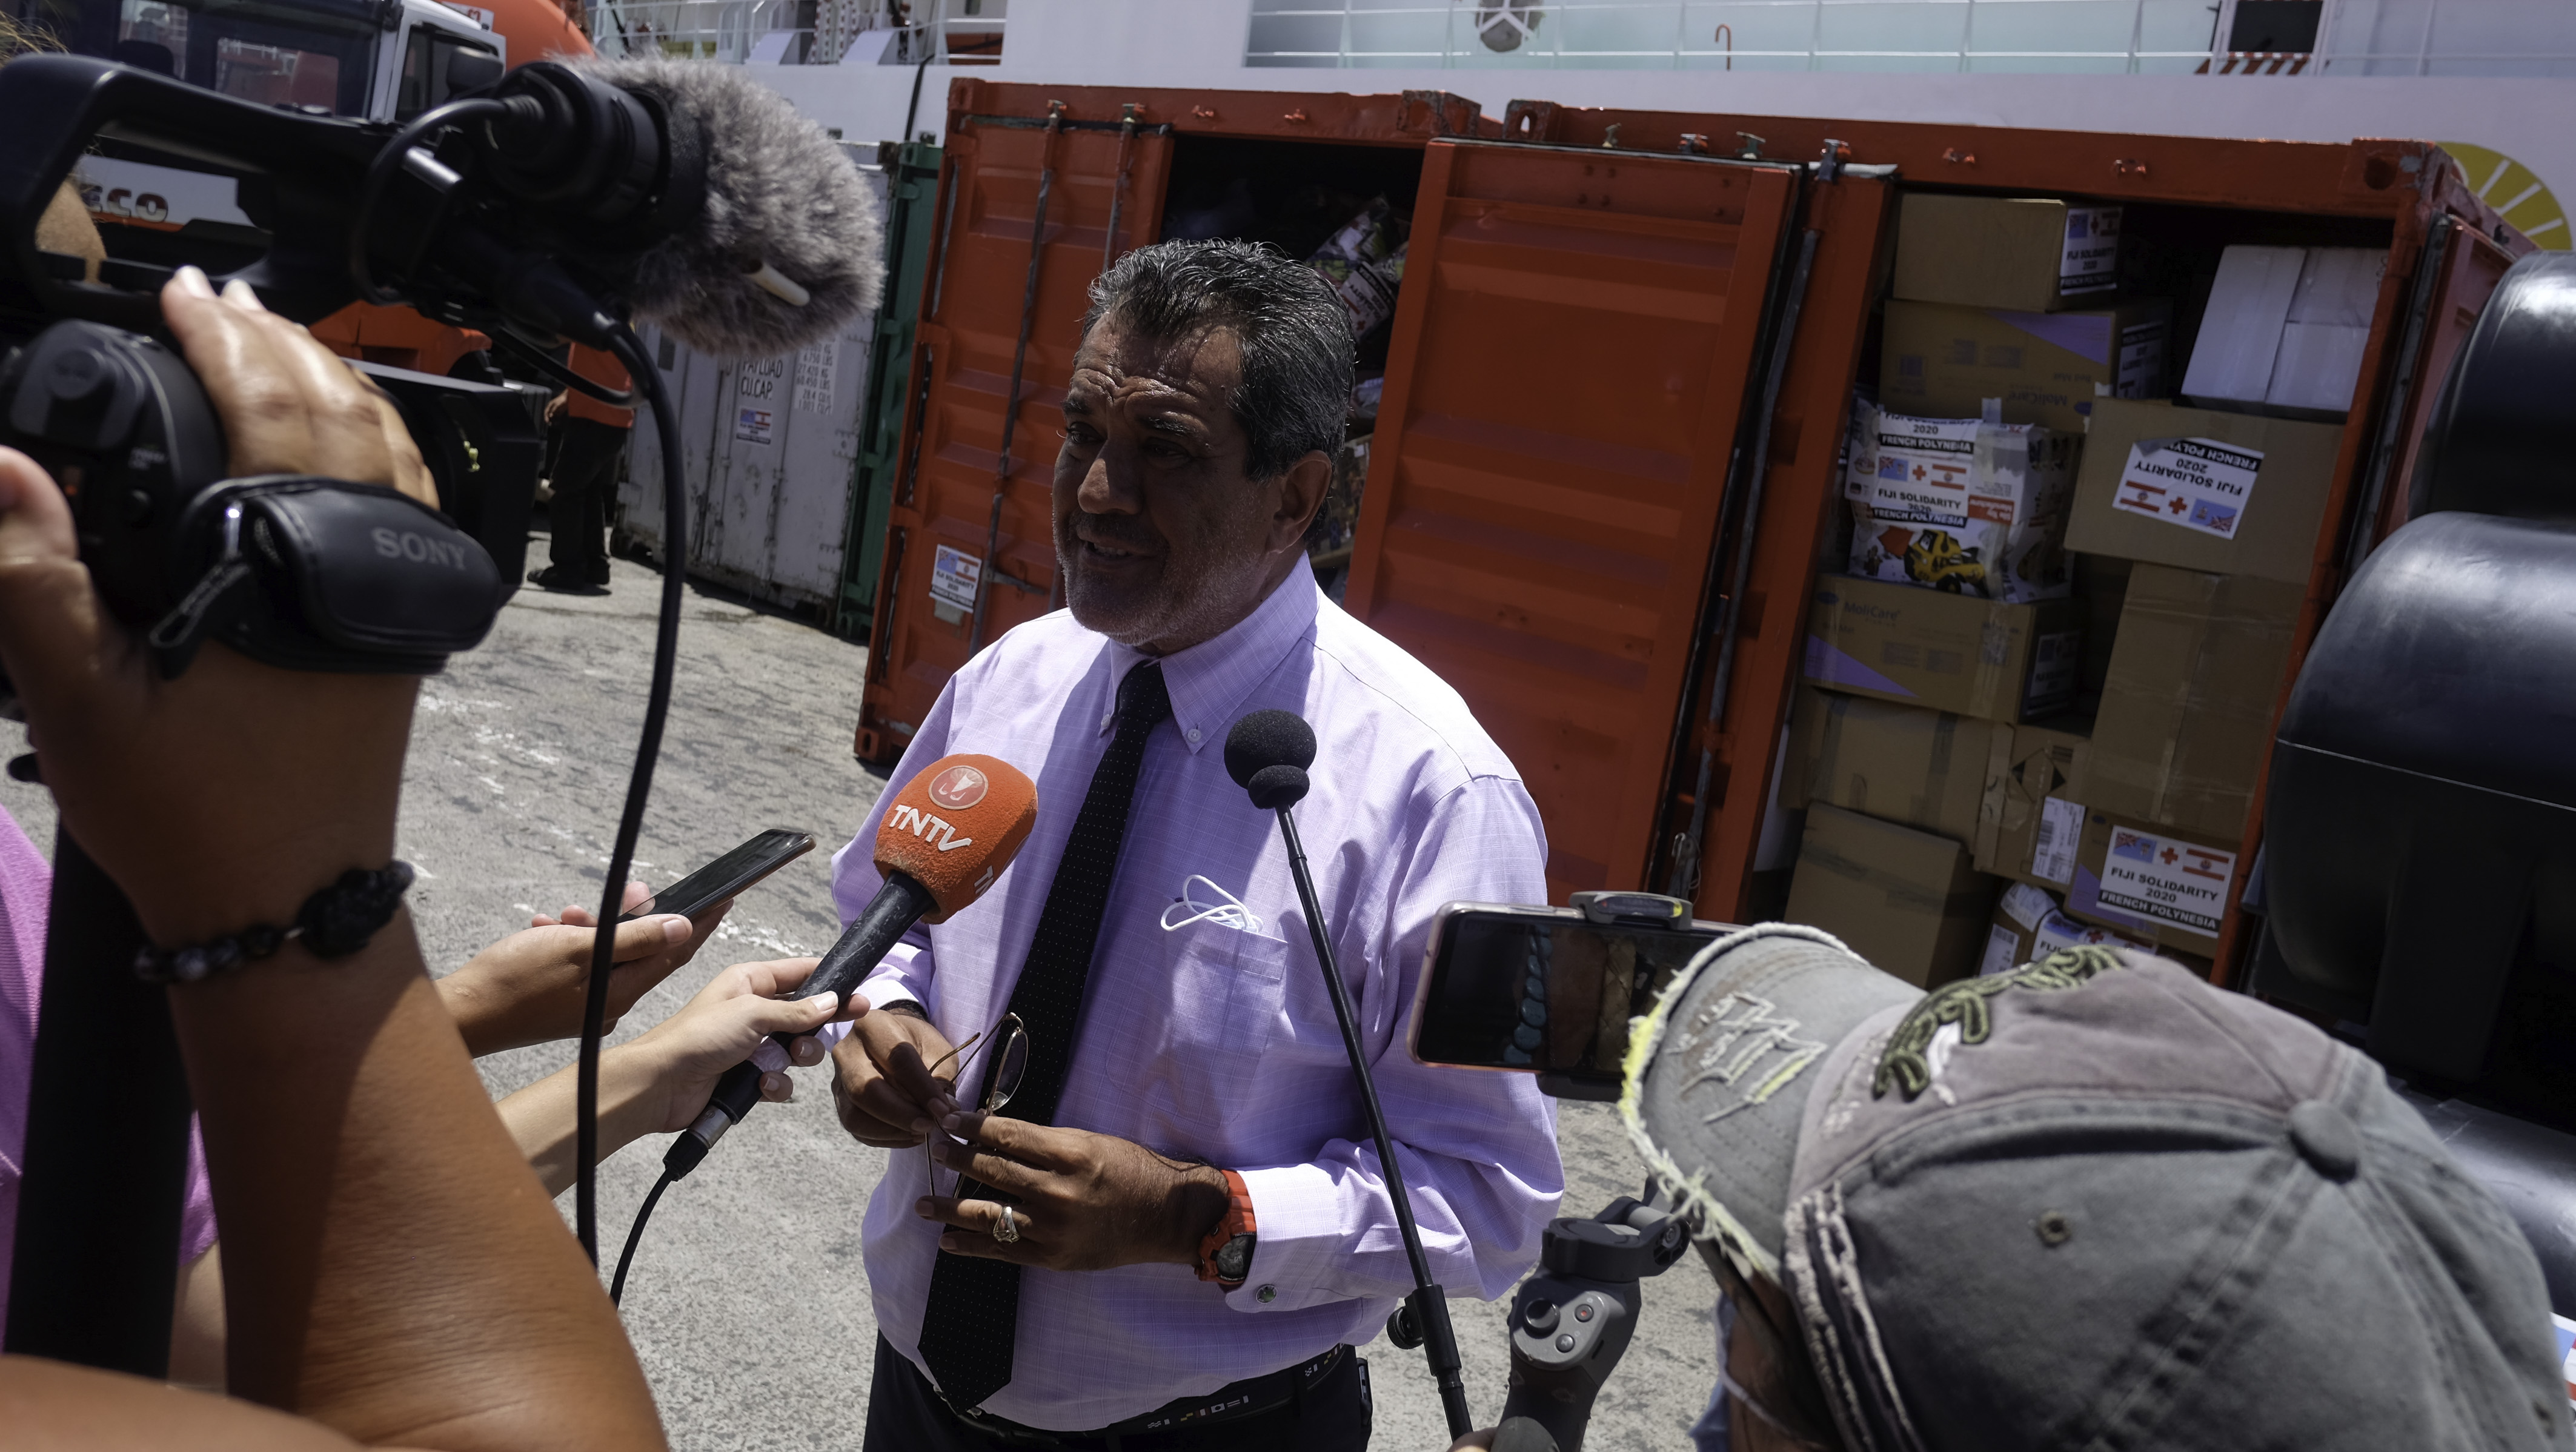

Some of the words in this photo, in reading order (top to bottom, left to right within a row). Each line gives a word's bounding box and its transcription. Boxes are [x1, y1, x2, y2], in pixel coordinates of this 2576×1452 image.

[2008, 391, 2067, 406] MoliCare
[1913, 424, 1939, 434] 2020
[1882, 436, 1917, 448] FRENCH
[2176, 459, 2209, 474] 2020
[2207, 451, 2257, 471] FRENCH
[2135, 461, 2214, 488] SOLIDARITY
[2216, 482, 2243, 496] FIJI
[1879, 489, 1897, 499] FIJI
[1899, 492, 1962, 510] SOLIDARITY
[1874, 508, 1909, 520] FRENCH
[1910, 512, 1965, 526] POLYNESIA
[371, 526, 466, 571] SONY
[1844, 602, 1899, 621] MoliCare
[889, 804, 973, 852] TNTV
[2111, 866, 2136, 881] FIJI
[2138, 874, 2219, 902] SOLIDARITY
[2145, 888, 2177, 903] 2020
[2101, 891, 2148, 912] FRENCH
[2150, 906, 2217, 929] POLYNESIA
